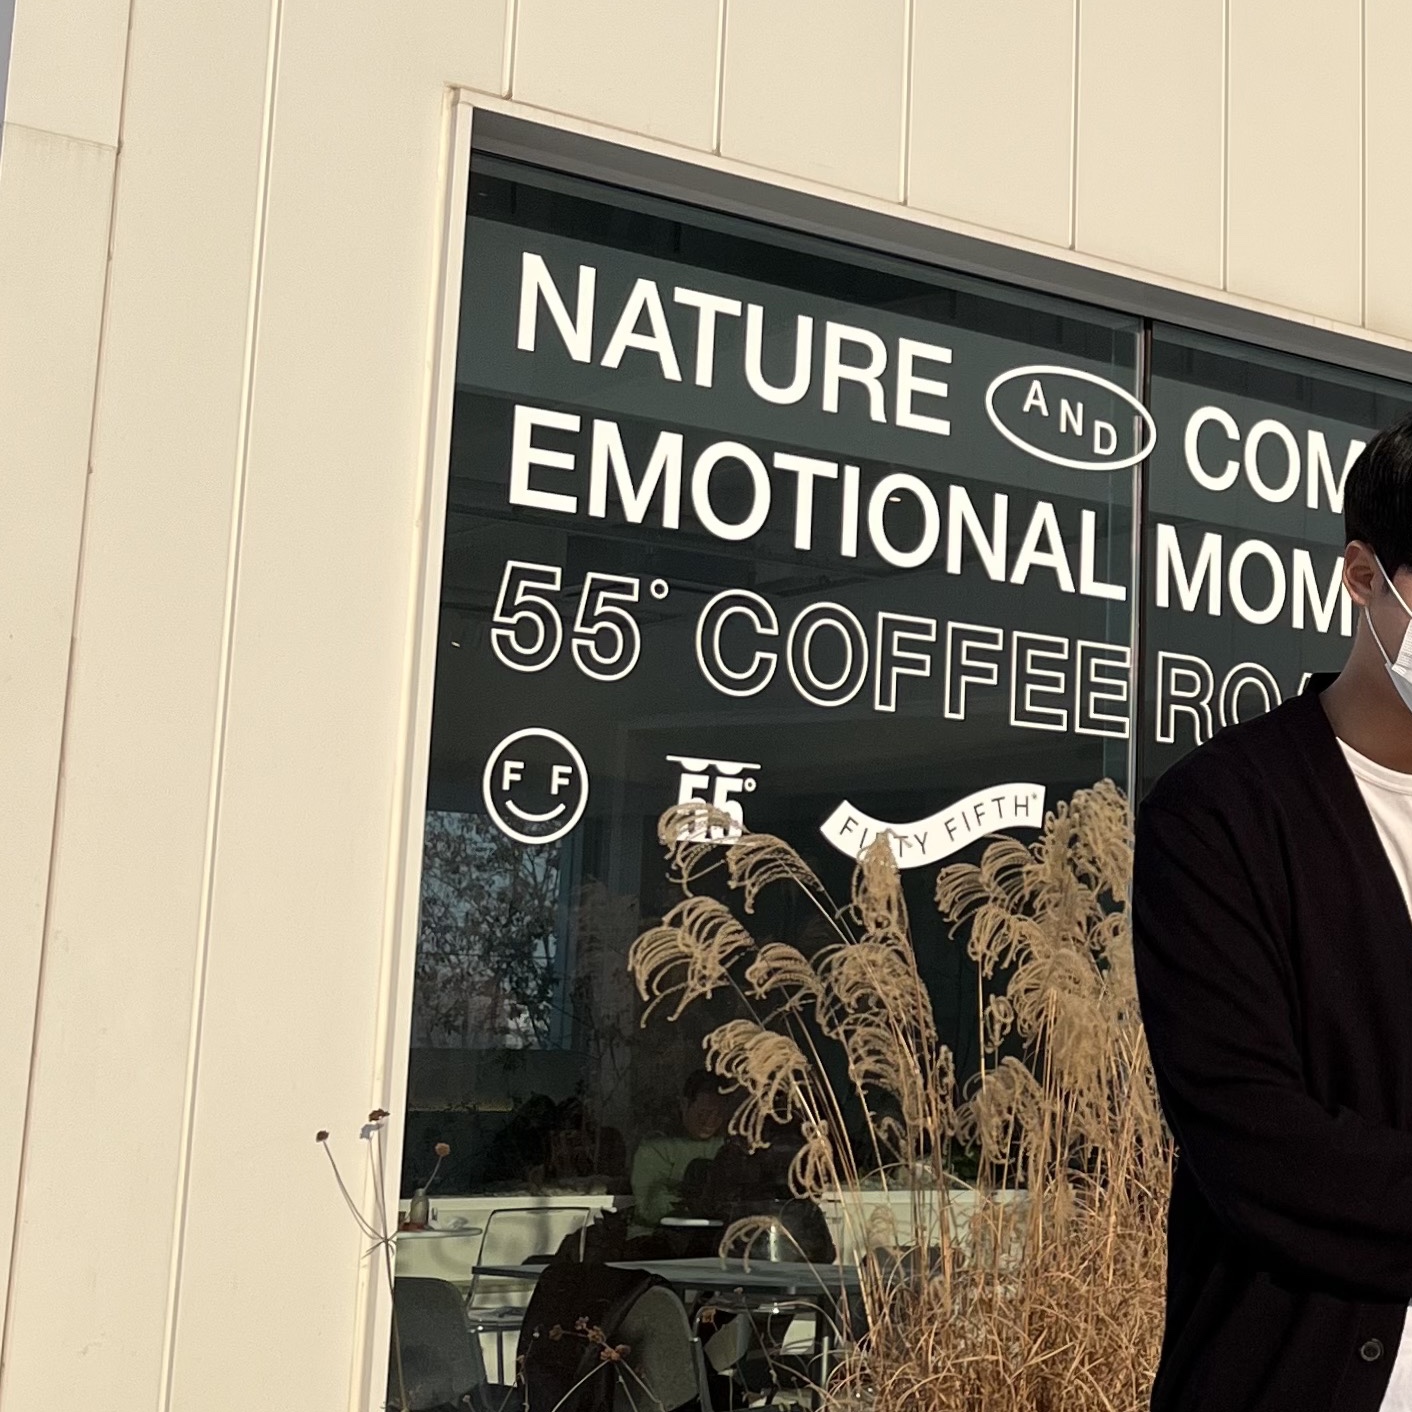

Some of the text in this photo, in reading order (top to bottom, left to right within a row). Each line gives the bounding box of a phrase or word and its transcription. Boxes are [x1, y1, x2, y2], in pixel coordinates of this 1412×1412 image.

[518, 252, 953, 435] NATURE
[1023, 380, 1118, 455] AND
[509, 405, 1127, 601] EMOTIONAL
[696, 589, 1132, 738] COFFEE
[1156, 651, 1313, 746] RO
[839, 816, 928, 858] FITY
